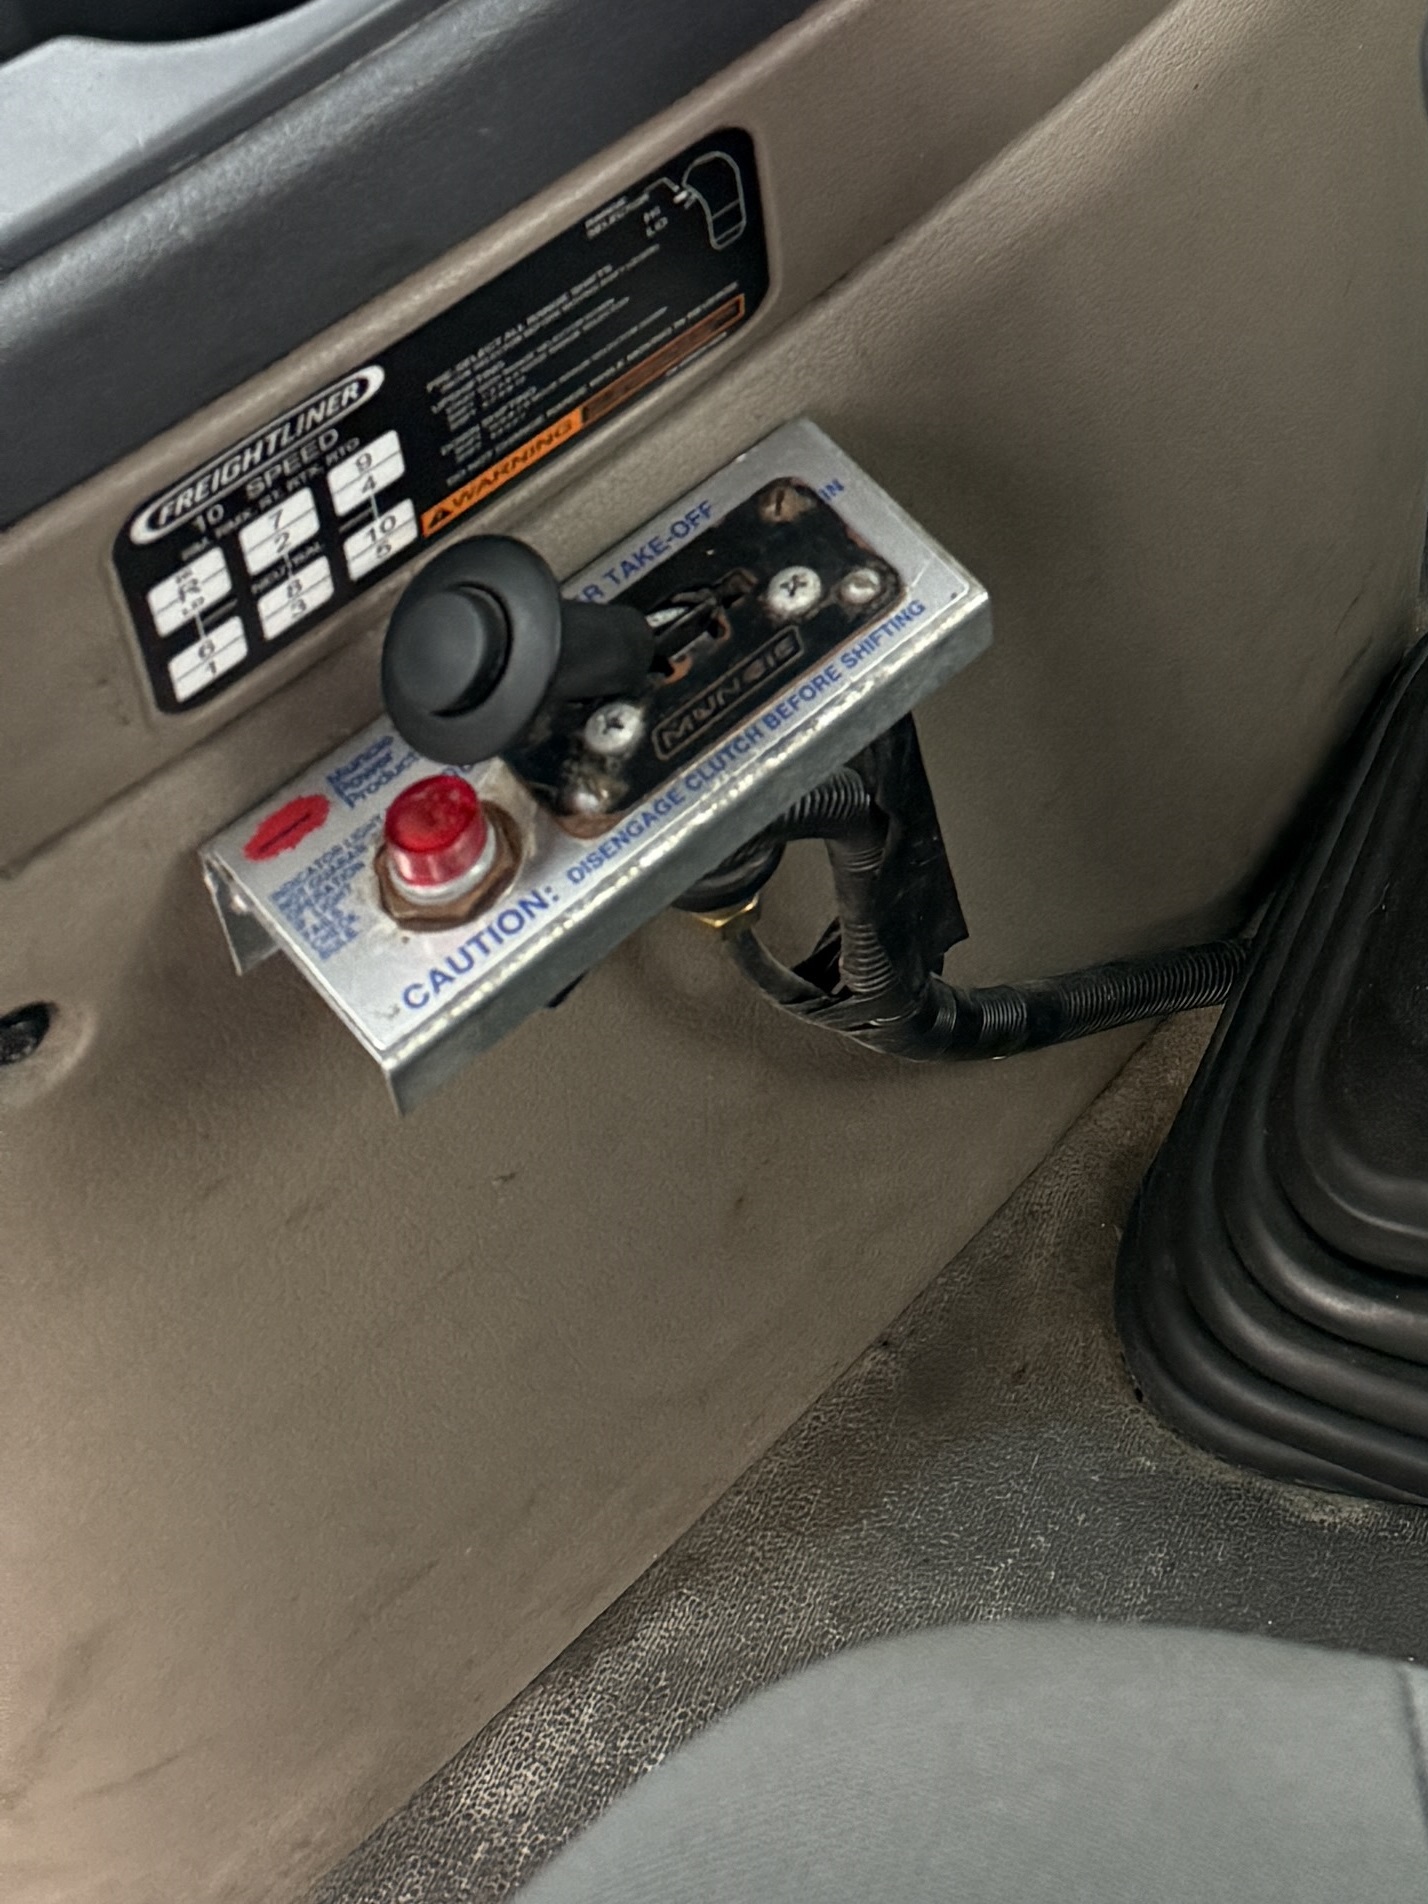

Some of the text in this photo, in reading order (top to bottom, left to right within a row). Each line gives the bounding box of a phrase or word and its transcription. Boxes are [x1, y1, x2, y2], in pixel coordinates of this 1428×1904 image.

[153, 375, 359, 523] FREIGHTLINER
[355, 453, 371, 473] 9
[453, 421, 571, 506] WARNING
[194, 429, 338, 531] 10 SPEED
[362, 475, 375, 492] 4
[822, 479, 844, 497] IN
[270, 509, 282, 529] 7
[367, 516, 395, 541] 10
[274, 531, 289, 552] 2
[376, 540, 390, 556] 5
[602, 500, 711, 583] TAKE-OFF
[177, 579, 200, 602] R
[287, 580, 301, 597] 8
[291, 599, 305, 615] 3
[198, 642, 214, 658] 6
[207, 660, 216, 673] 1
[653, 638, 802, 746] MUNCIE
[327, 736, 392, 784] Muncie
[336, 751, 392, 796] Power
[344, 752, 415, 808] Product
[402, 887, 558, 1009] CAUTION:
[566, 789, 685, 884] DISENGAGE
[685, 726, 763, 790] CLUTCH
[762, 665, 841, 729] BEFORE
[841, 599, 926, 668] SHIFTING
